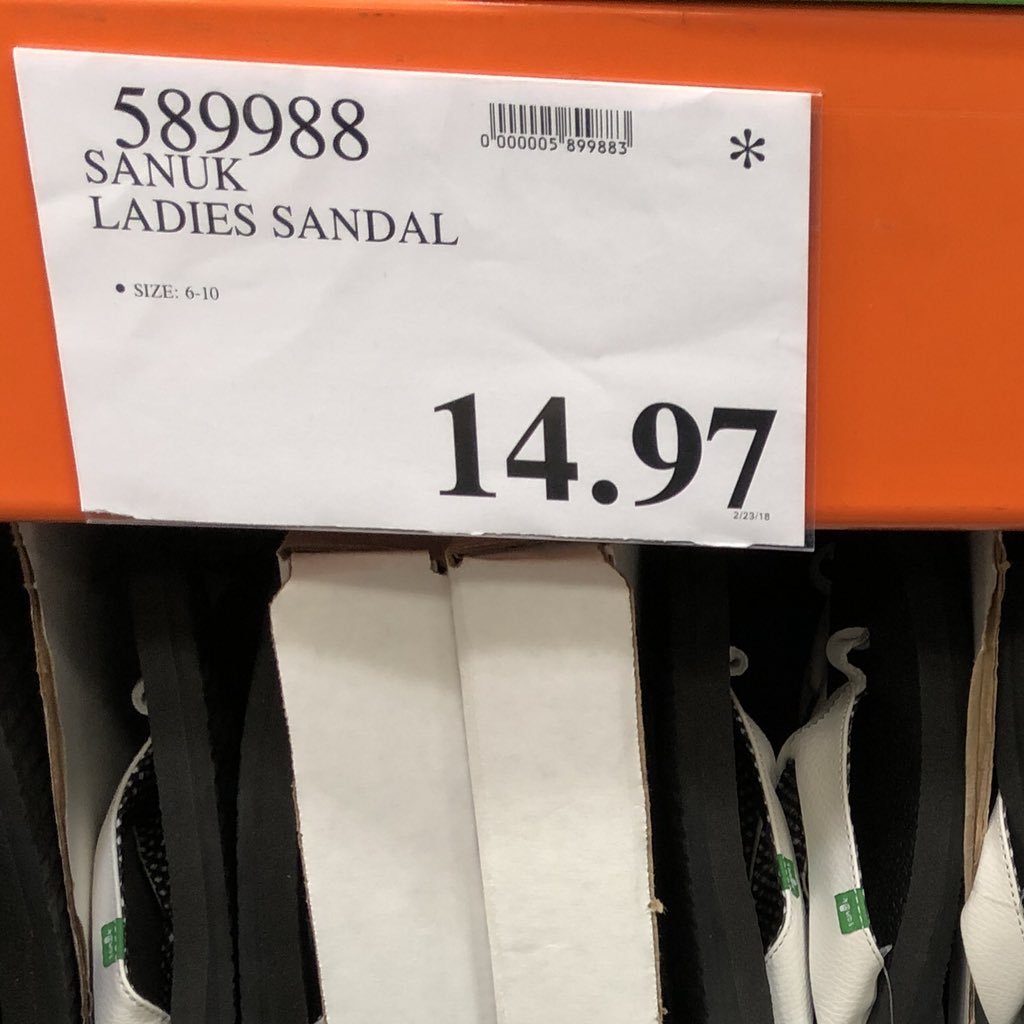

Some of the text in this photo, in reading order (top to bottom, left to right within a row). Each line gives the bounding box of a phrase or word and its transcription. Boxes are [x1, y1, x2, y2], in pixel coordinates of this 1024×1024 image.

[113, 86, 369, 161] 589988
[480, 133, 628, 155] 0 000005 899883
[84, 149, 247, 192] SANUK
[88, 195, 460, 246] LADIES SANDAL
[133, 282, 220, 301] SIZE: 6-10
[433, 392, 778, 510] 14.97
[732, 511, 771, 521] 2/23/18
